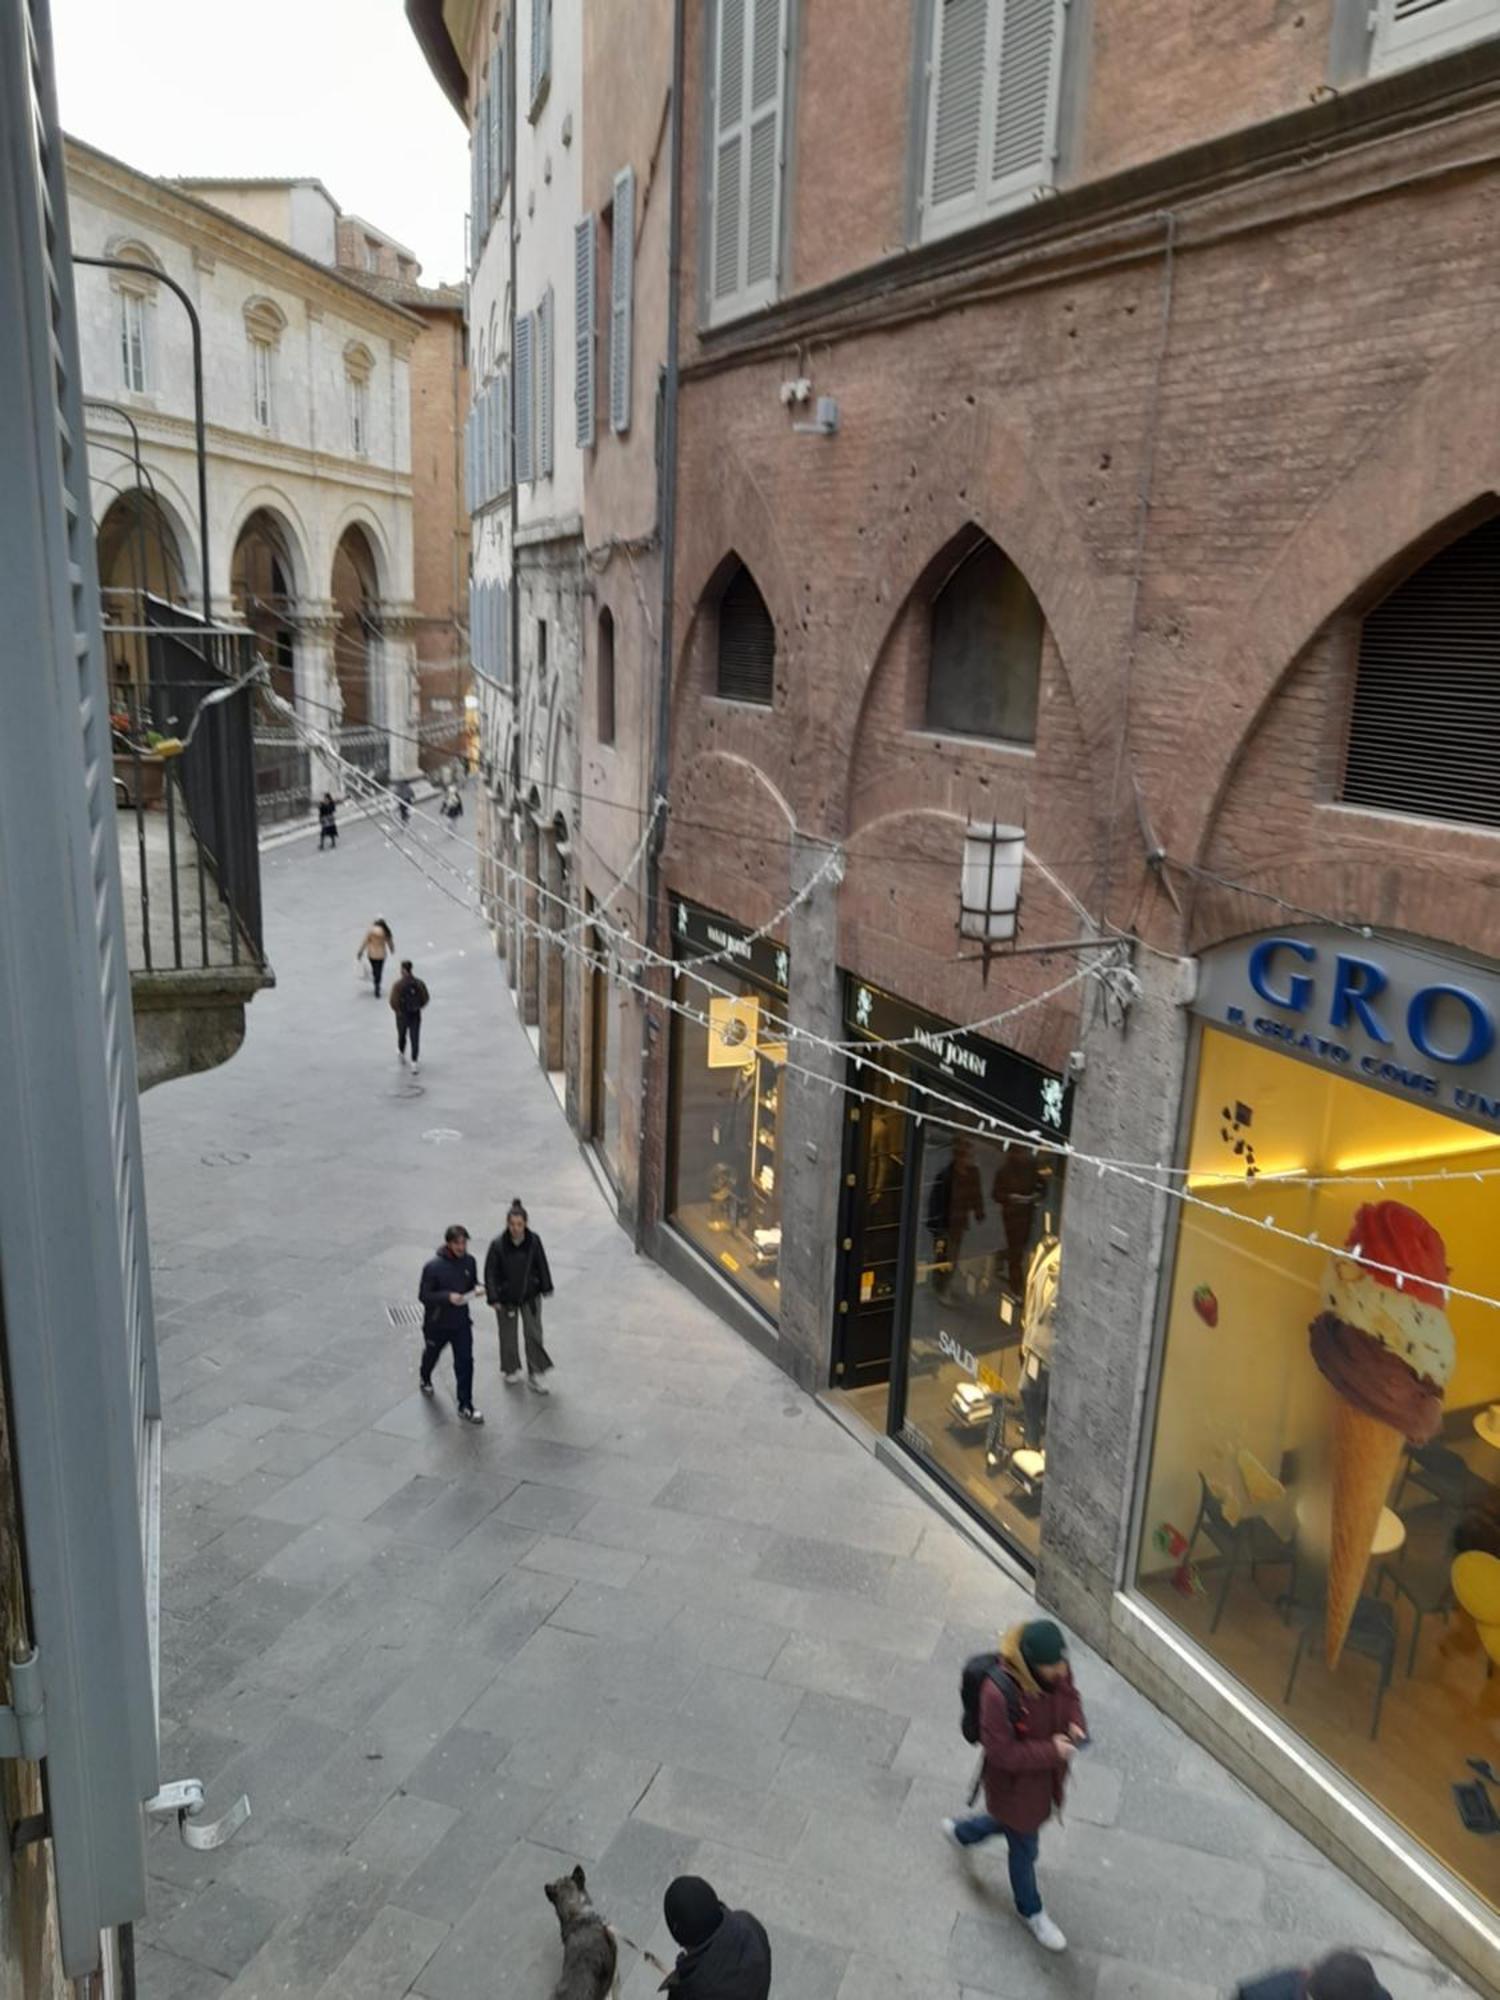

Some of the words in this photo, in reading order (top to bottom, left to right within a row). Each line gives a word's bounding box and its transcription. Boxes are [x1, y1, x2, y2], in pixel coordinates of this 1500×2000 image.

[1248, 937, 1495, 1066] GRO
[944, 1042, 987, 1078] JOHN
[1254, 1017, 1351, 1062] GELATO
[1360, 1056, 1437, 1096] COME
